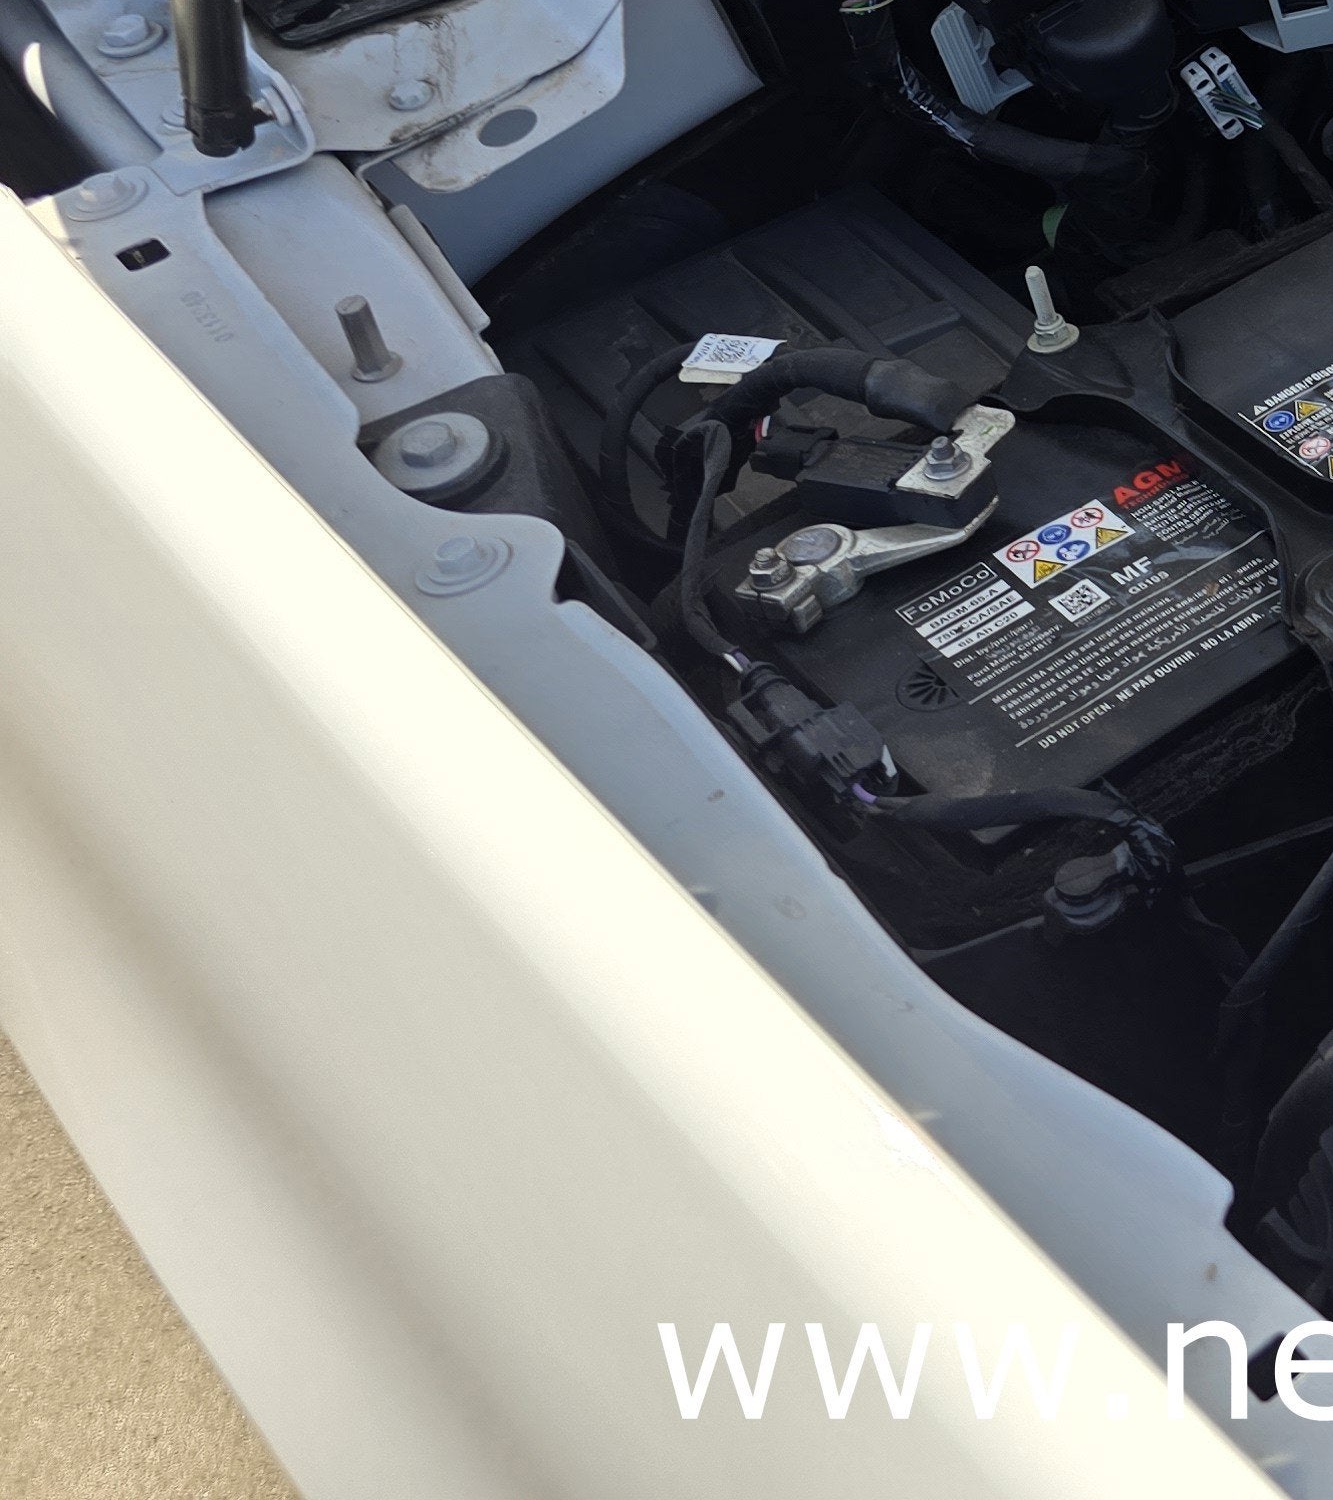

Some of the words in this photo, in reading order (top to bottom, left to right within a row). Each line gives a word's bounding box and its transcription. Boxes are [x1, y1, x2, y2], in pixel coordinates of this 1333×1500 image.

[1109, 453, 1184, 506] AGM
[901, 564, 991, 622] FoMoCo
[1110, 553, 1155, 588] MF
[1037, 732, 1058, 749] DO
[1055, 719, 1082, 739] NOT
[1078, 698, 1116, 725] OPEN.
[1114, 686, 1134, 702] NE
[1130, 672, 1156, 692] PAS
[1152, 646, 1200, 679] OUVRIR.
[1199, 635, 1219, 651] NO
[1216, 626, 1234, 643] LA
[1230, 608, 1265, 634] ABRA.
